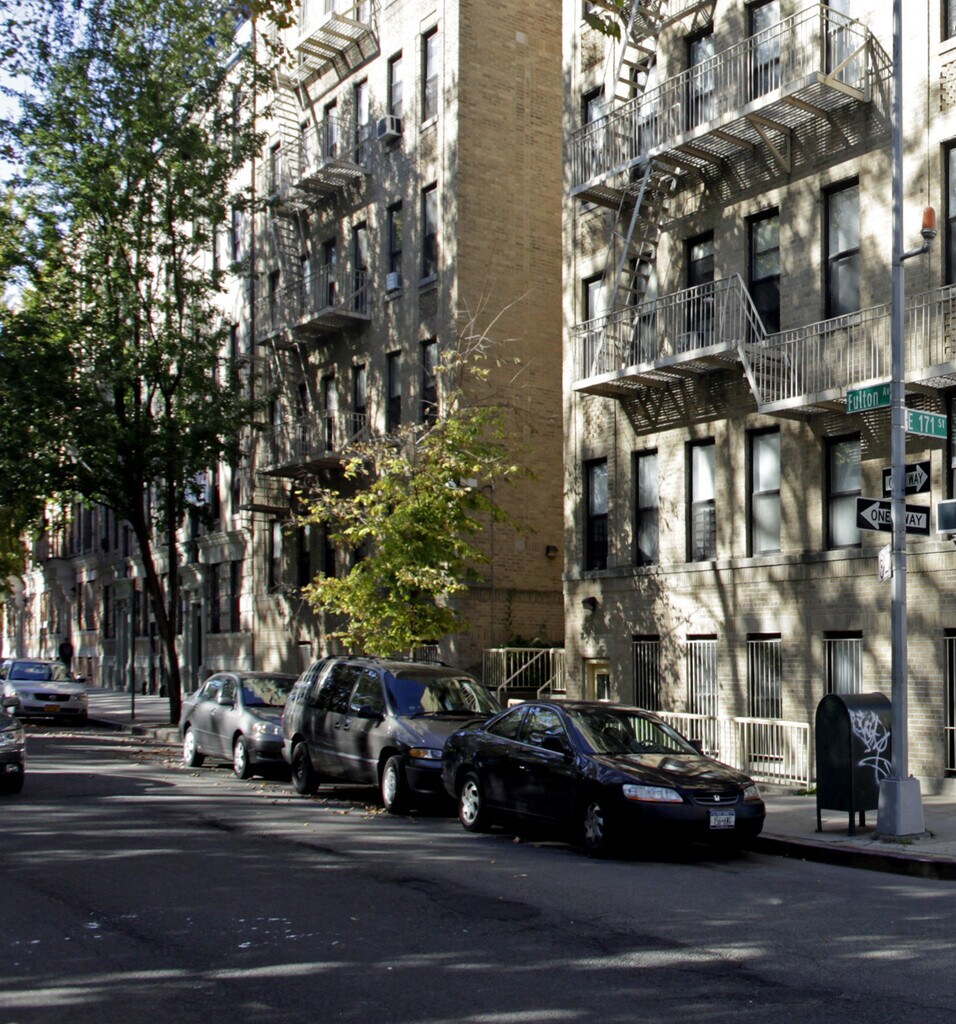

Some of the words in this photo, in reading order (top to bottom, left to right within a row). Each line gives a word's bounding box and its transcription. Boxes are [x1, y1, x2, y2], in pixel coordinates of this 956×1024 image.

[848, 390, 879, 411] Fulton
[907, 413, 914, 430] E
[918, 416, 935, 434] 171
[937, 419, 945, 429] St
[908, 471, 923, 485] WAY
[870, 509, 891, 523] ONE
